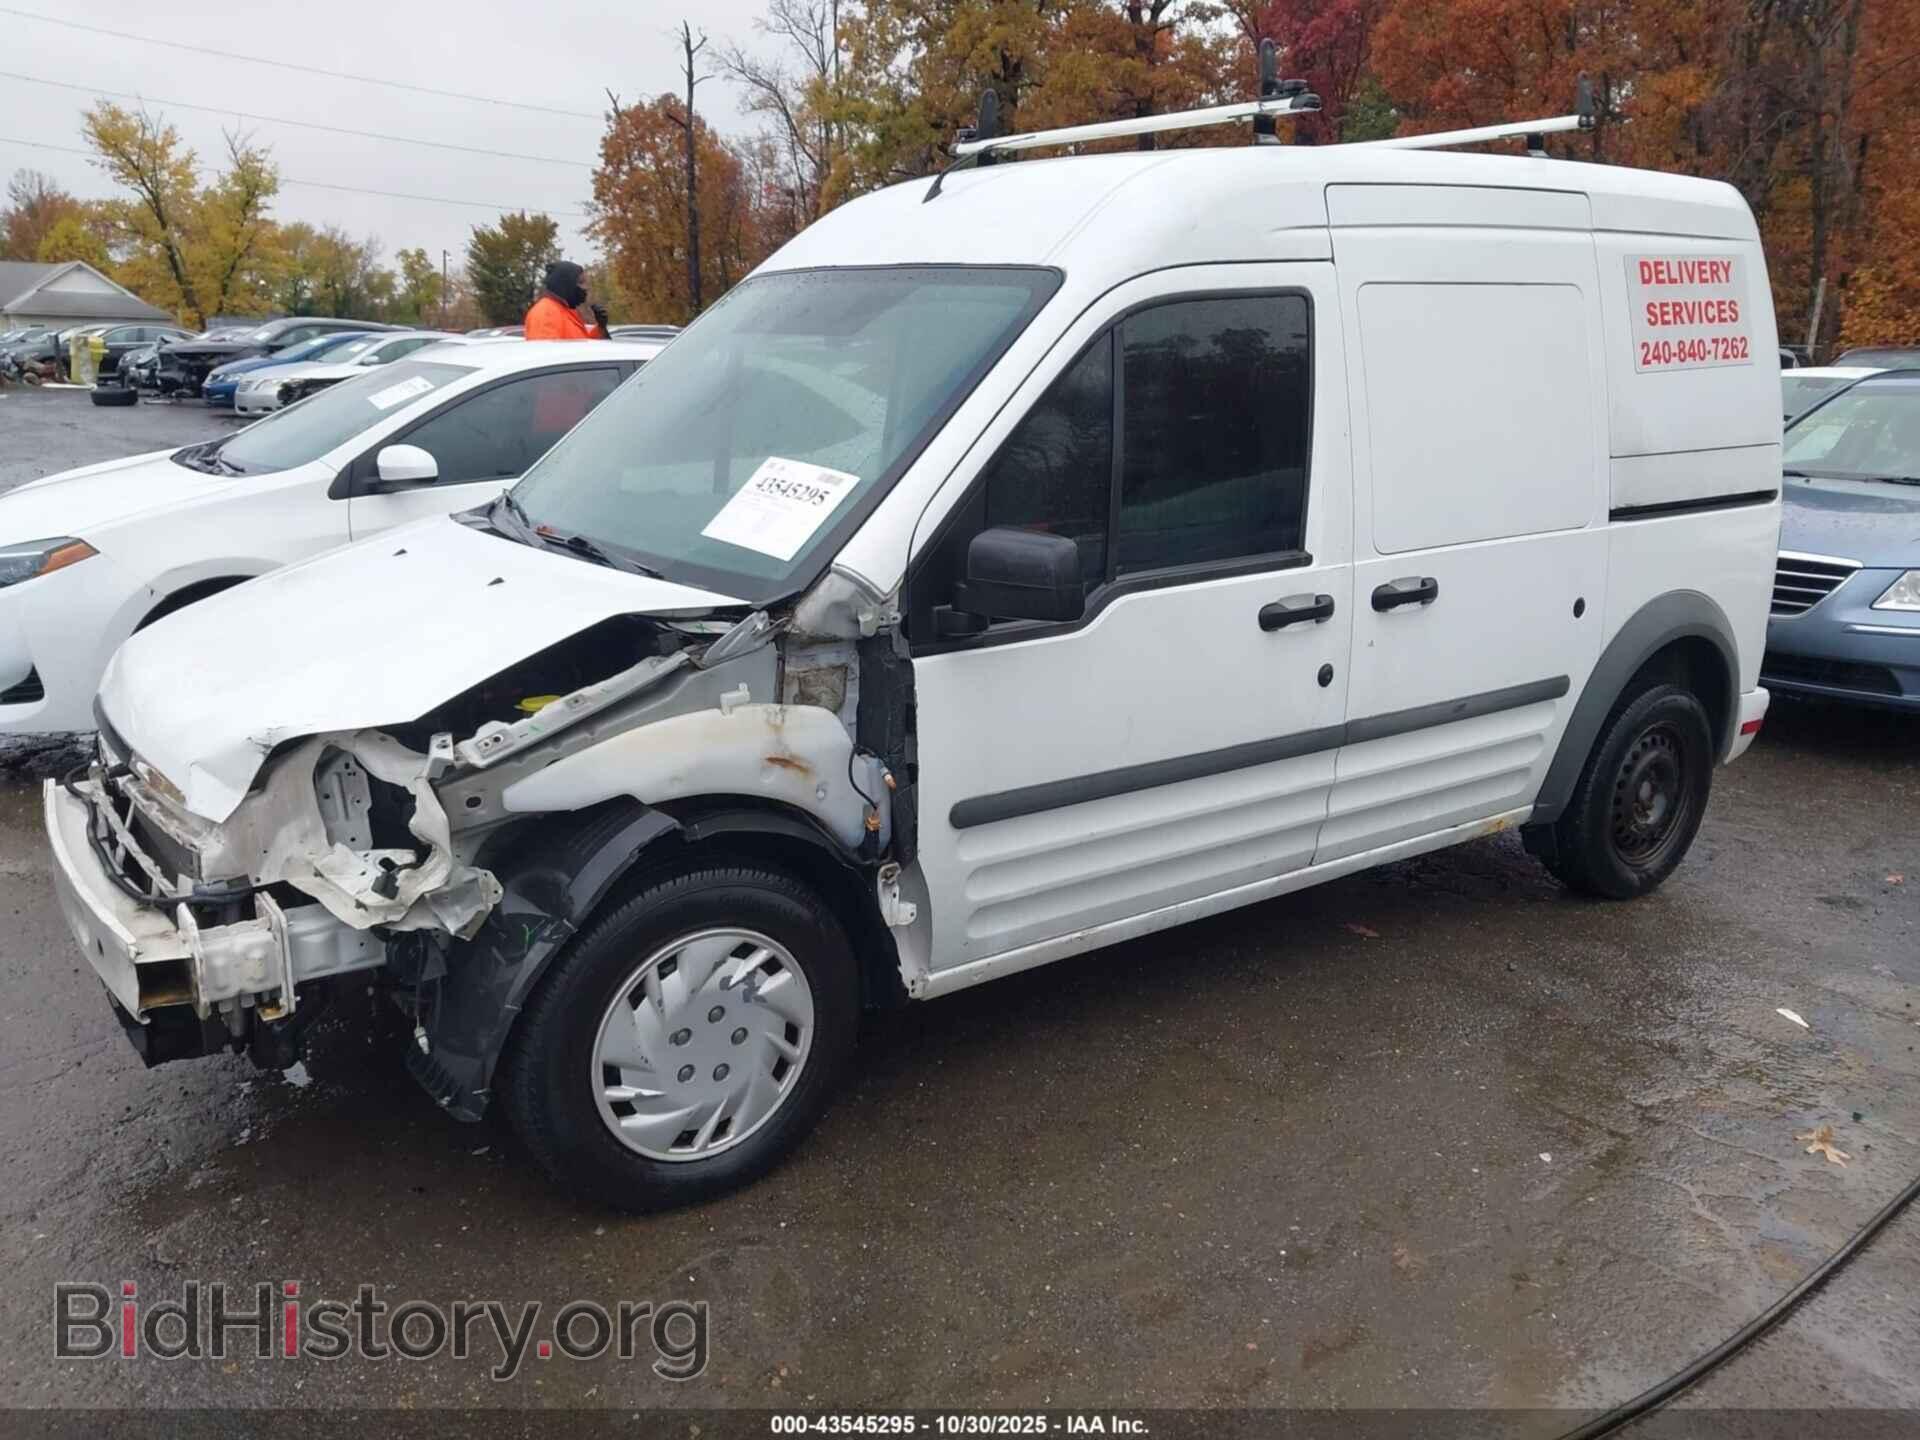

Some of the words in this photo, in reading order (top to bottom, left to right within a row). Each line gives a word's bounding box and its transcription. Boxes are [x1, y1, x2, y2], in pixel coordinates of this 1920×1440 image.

[1639, 260, 1732, 285] DELIVERY
[1646, 300, 1739, 326] SERVICES
[1640, 336, 1749, 365] 240-840-7262
[756, 477, 831, 506] 43545295
